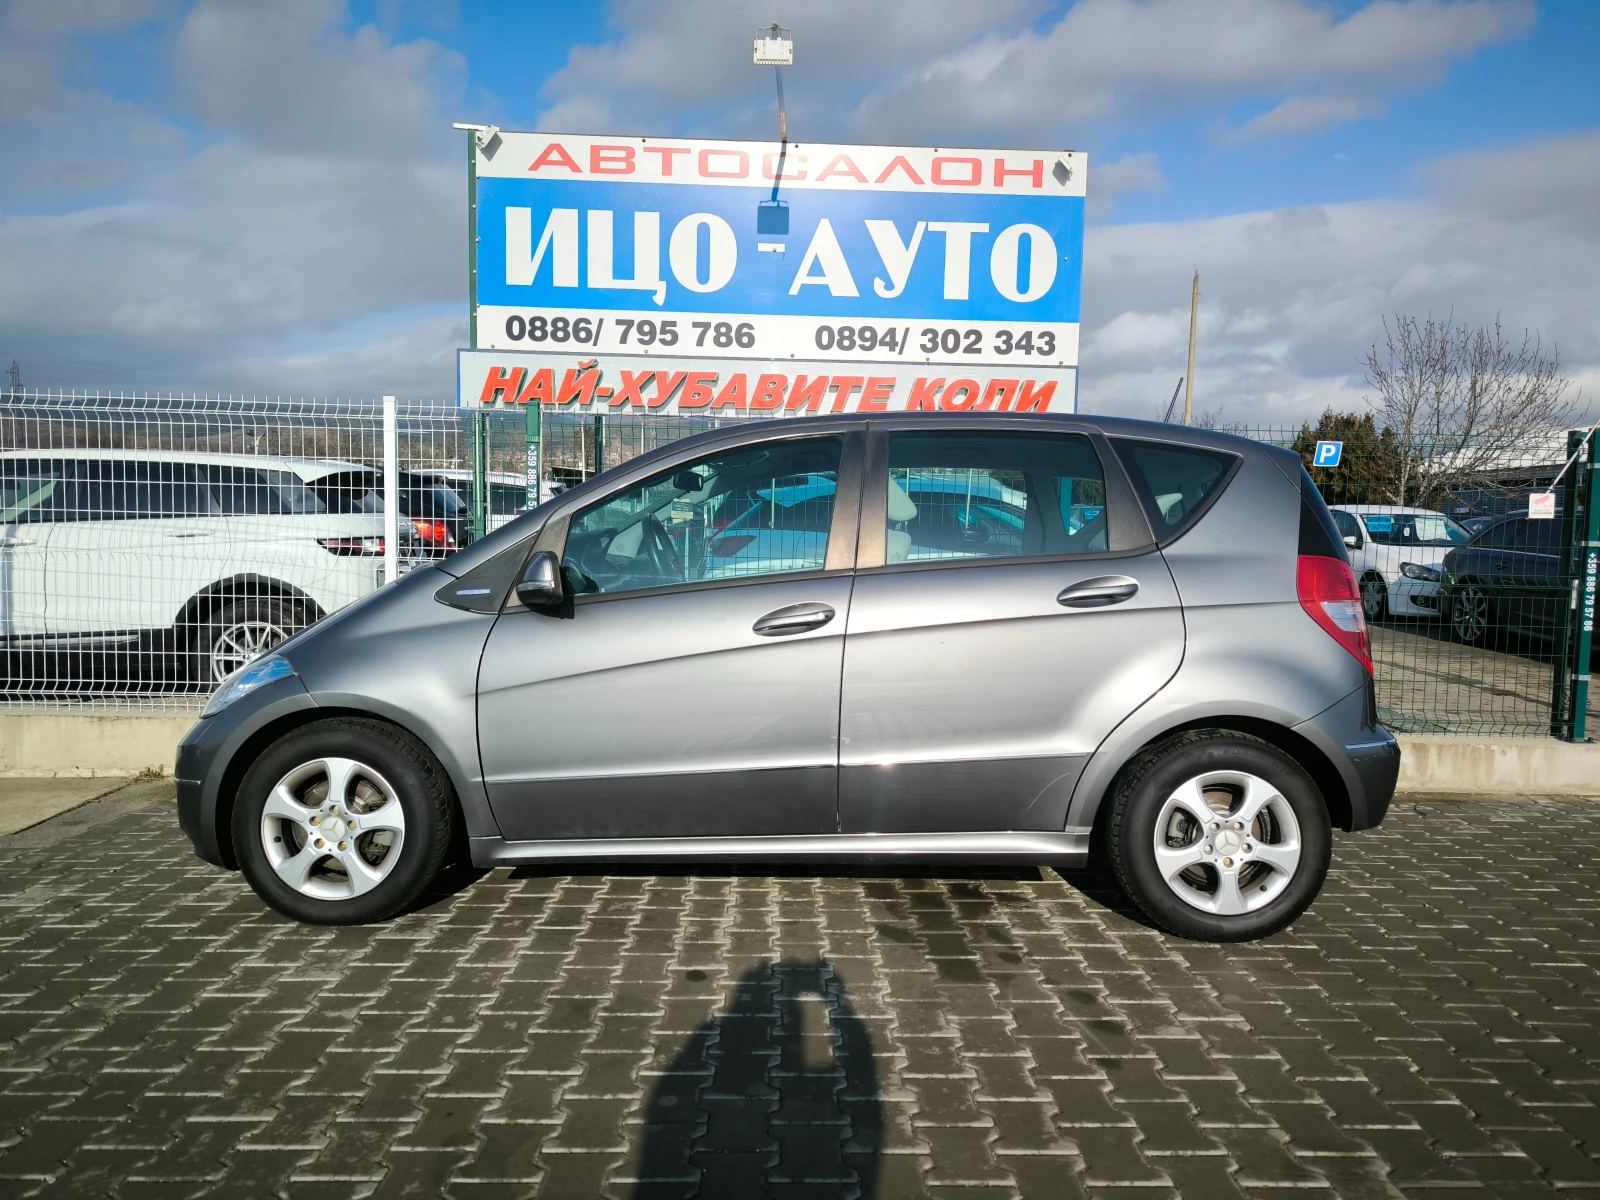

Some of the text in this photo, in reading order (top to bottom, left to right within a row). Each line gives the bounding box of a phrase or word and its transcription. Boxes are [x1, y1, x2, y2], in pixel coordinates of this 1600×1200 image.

[527, 143, 1043, 188] АВТОСАЛОН
[505, 315, 756, 349] 0886/ 795 786
[815, 325, 1056, 356] 0894/ 302 343
[479, 358, 1059, 414] НАЙ-ХУБАВИТЕ КОЛИ
[528, 445, 537, 466] +359
[1319, 444, 1336, 463] P
[528, 469, 536, 485] 886
[528, 488, 537, 499] 79
[1583, 552, 1597, 631] +359 886 79 57 86
